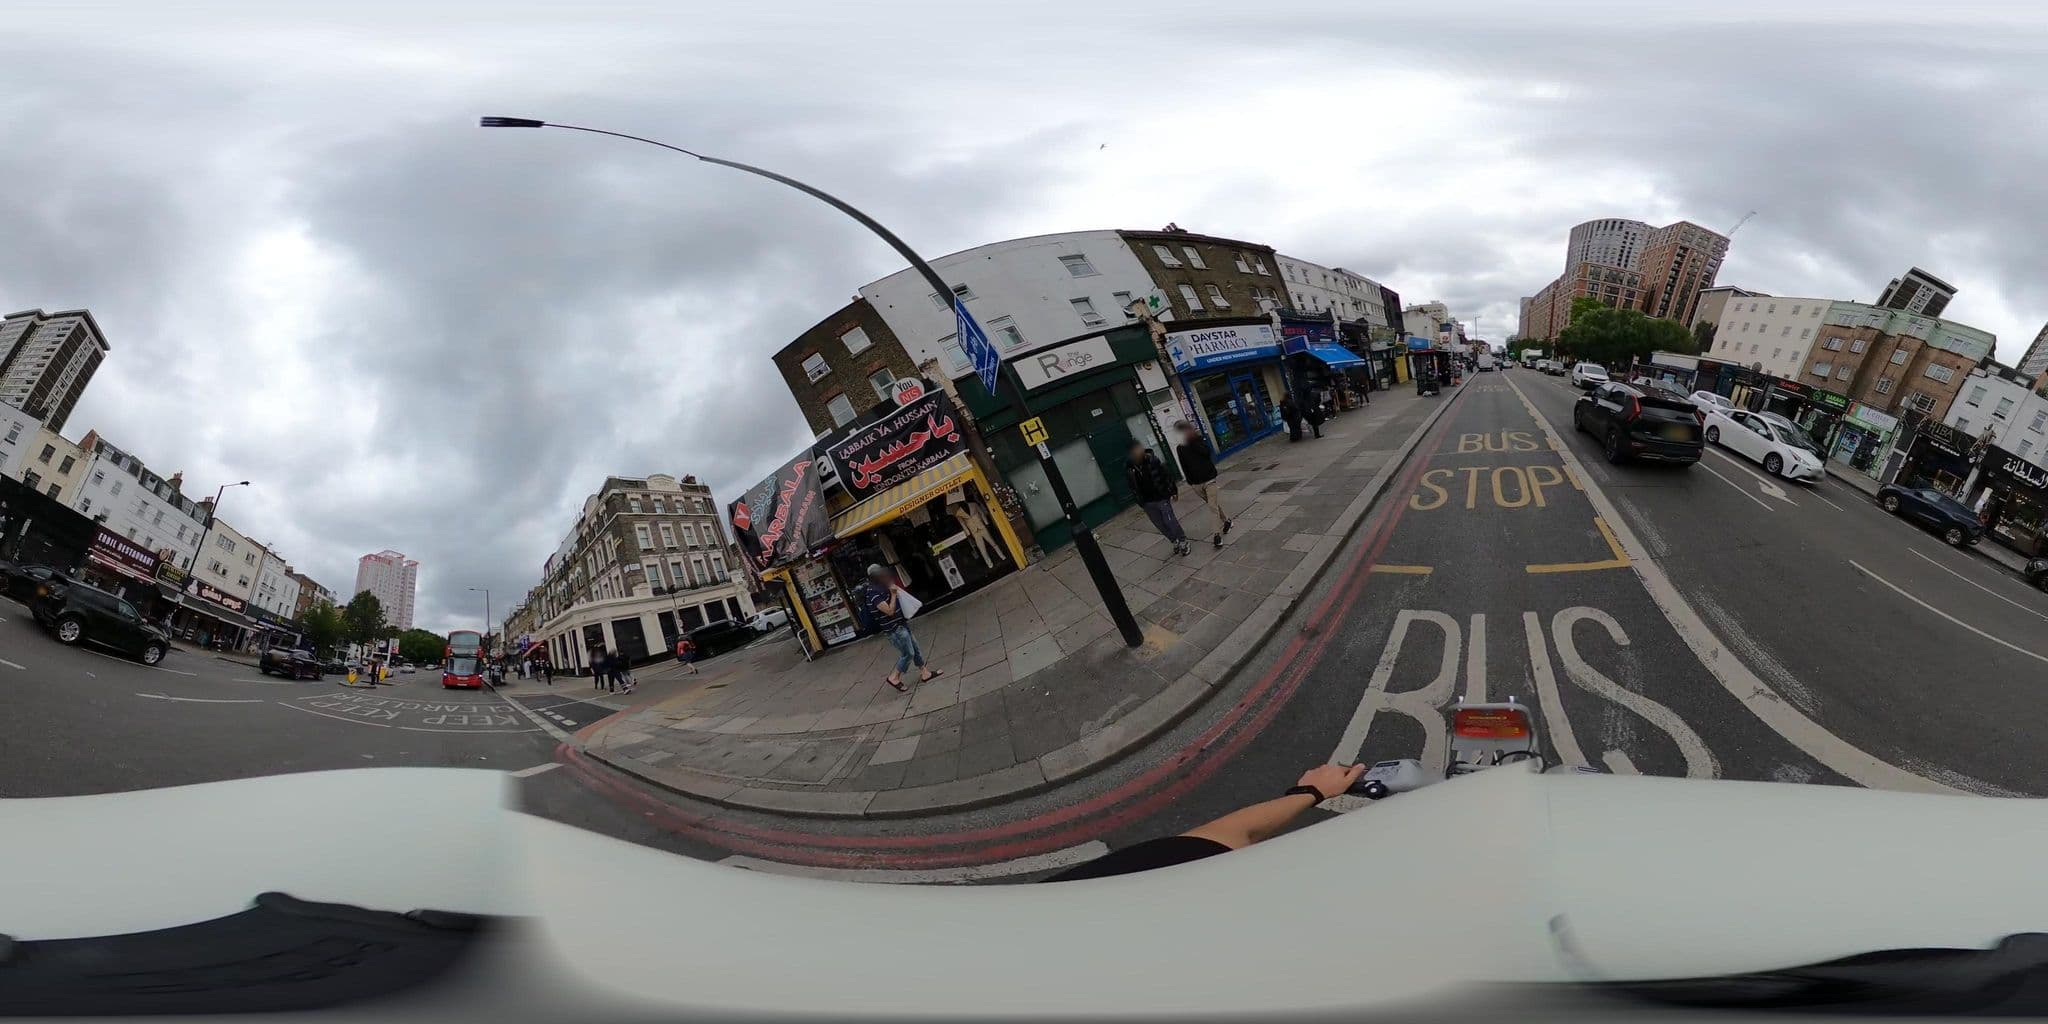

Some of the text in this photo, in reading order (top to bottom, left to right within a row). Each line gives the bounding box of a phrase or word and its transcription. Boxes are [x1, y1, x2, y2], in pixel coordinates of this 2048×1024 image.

[1190, 330, 1237, 343] DAYSTAR
[1037, 353, 1093, 379] Range
[838, 400, 938, 460] LABBAIK YA HUSSAIN
[1023, 420, 1045, 443] H
[1928, 421, 1953, 441] HIBA
[1458, 430, 1540, 454] BUS
[897, 456, 918, 471] FROM
[917, 449, 950, 471] KARBALA
[899, 476, 962, 514] DESIGNER OUTLET
[1408, 465, 1565, 511] STOP
[1321, 606, 1721, 808] BUS
[422, 714, 520, 726] KEEP
